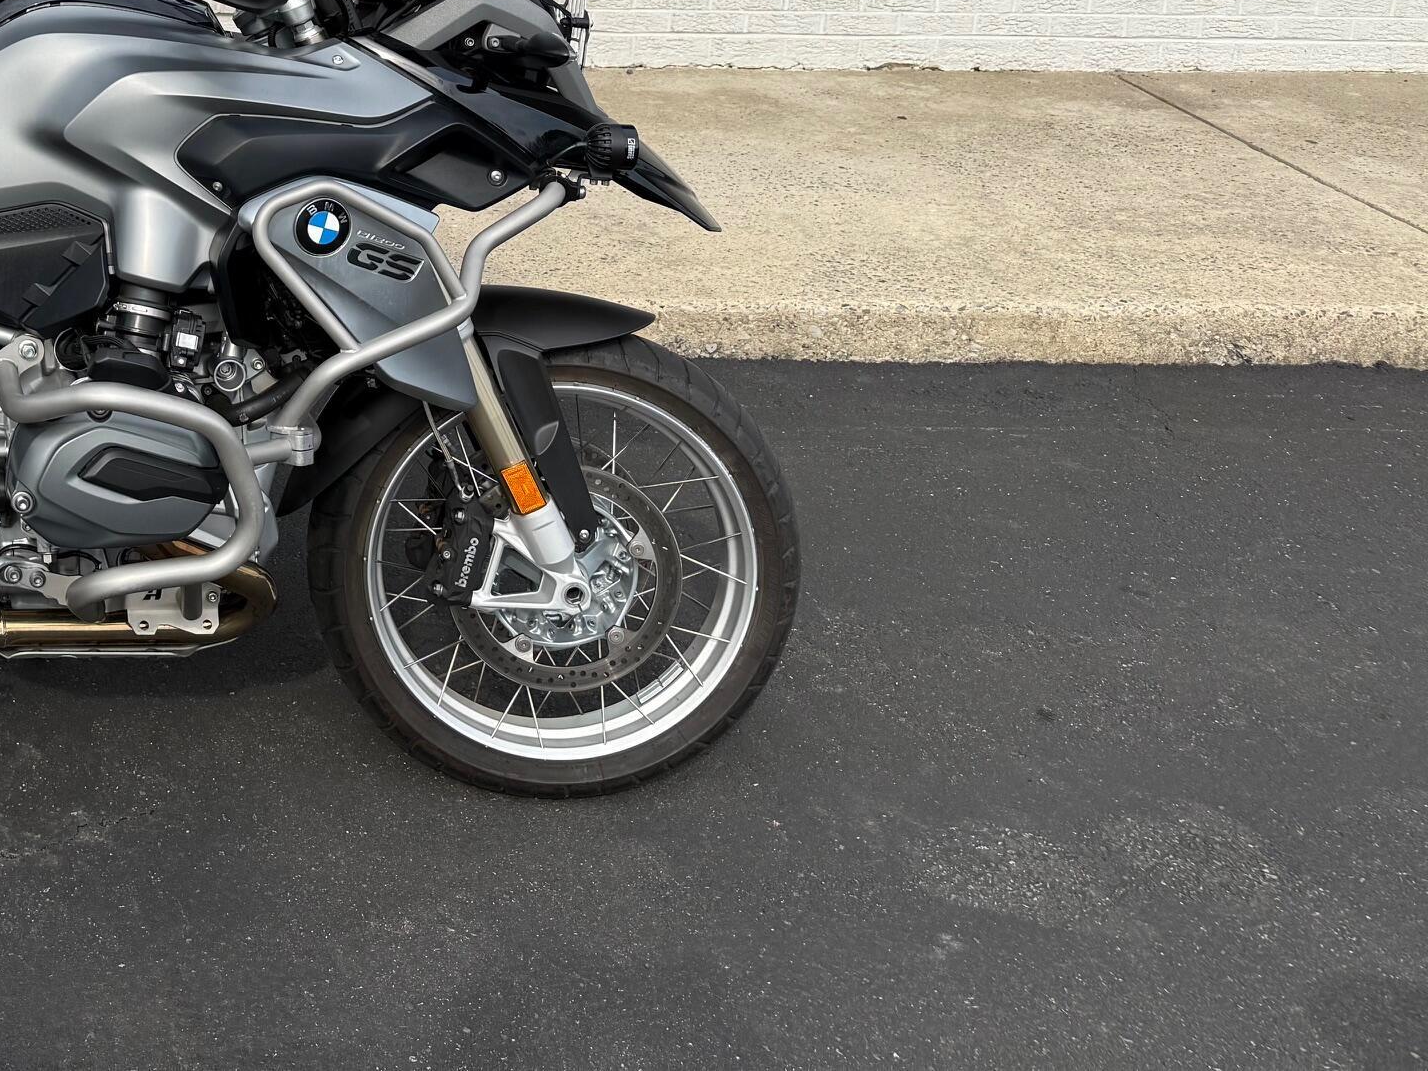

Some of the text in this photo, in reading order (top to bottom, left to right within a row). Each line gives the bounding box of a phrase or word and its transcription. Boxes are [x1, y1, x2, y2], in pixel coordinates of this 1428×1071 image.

[307, 201, 348, 224] BMW
[346, 242, 425, 283] GS
[455, 537, 479, 588] brembo
